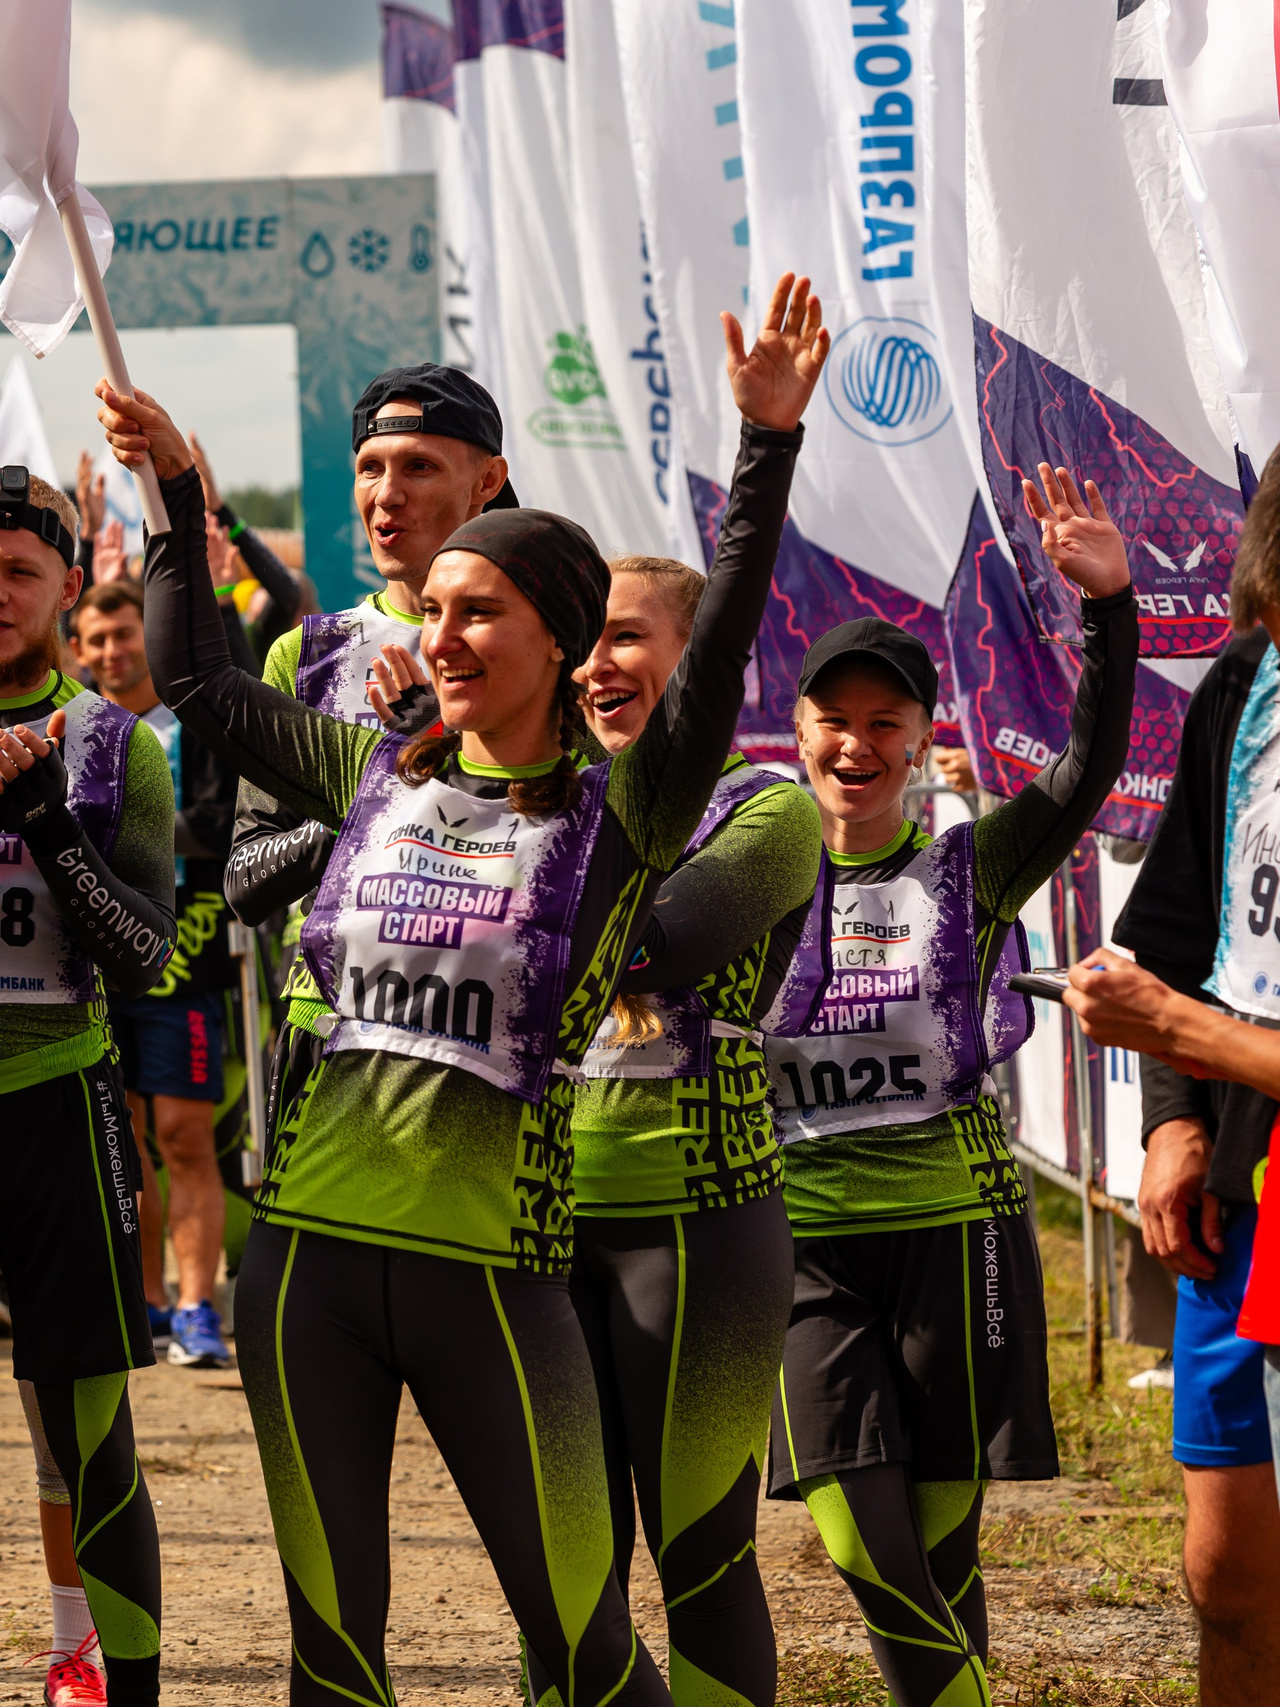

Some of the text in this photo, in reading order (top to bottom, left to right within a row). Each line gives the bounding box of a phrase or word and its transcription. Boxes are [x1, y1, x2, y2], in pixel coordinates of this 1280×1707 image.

[386, 823, 517, 855] ГОНКА ГЕРОЕВ
[242, 854, 297, 887] GLOBAL
[56, 846, 164, 969] Greenway
[361, 878, 505, 917] МАССОВЫЙ
[70, 896, 124, 960] GLOBAL
[383, 911, 460, 945] СТАРТ
[842, 921, 911, 939] ГЕРОЕВ
[832, 948, 887, 967] астя
[825, 967, 913, 1000] СОВЫЙ
[349, 966, 495, 1044] 1000
[780, 1054, 927, 1107] 1025
[96, 1080, 137, 1236] #ТыМожешьВсё
[983, 1218, 1006, 1349] МожешьВсё
